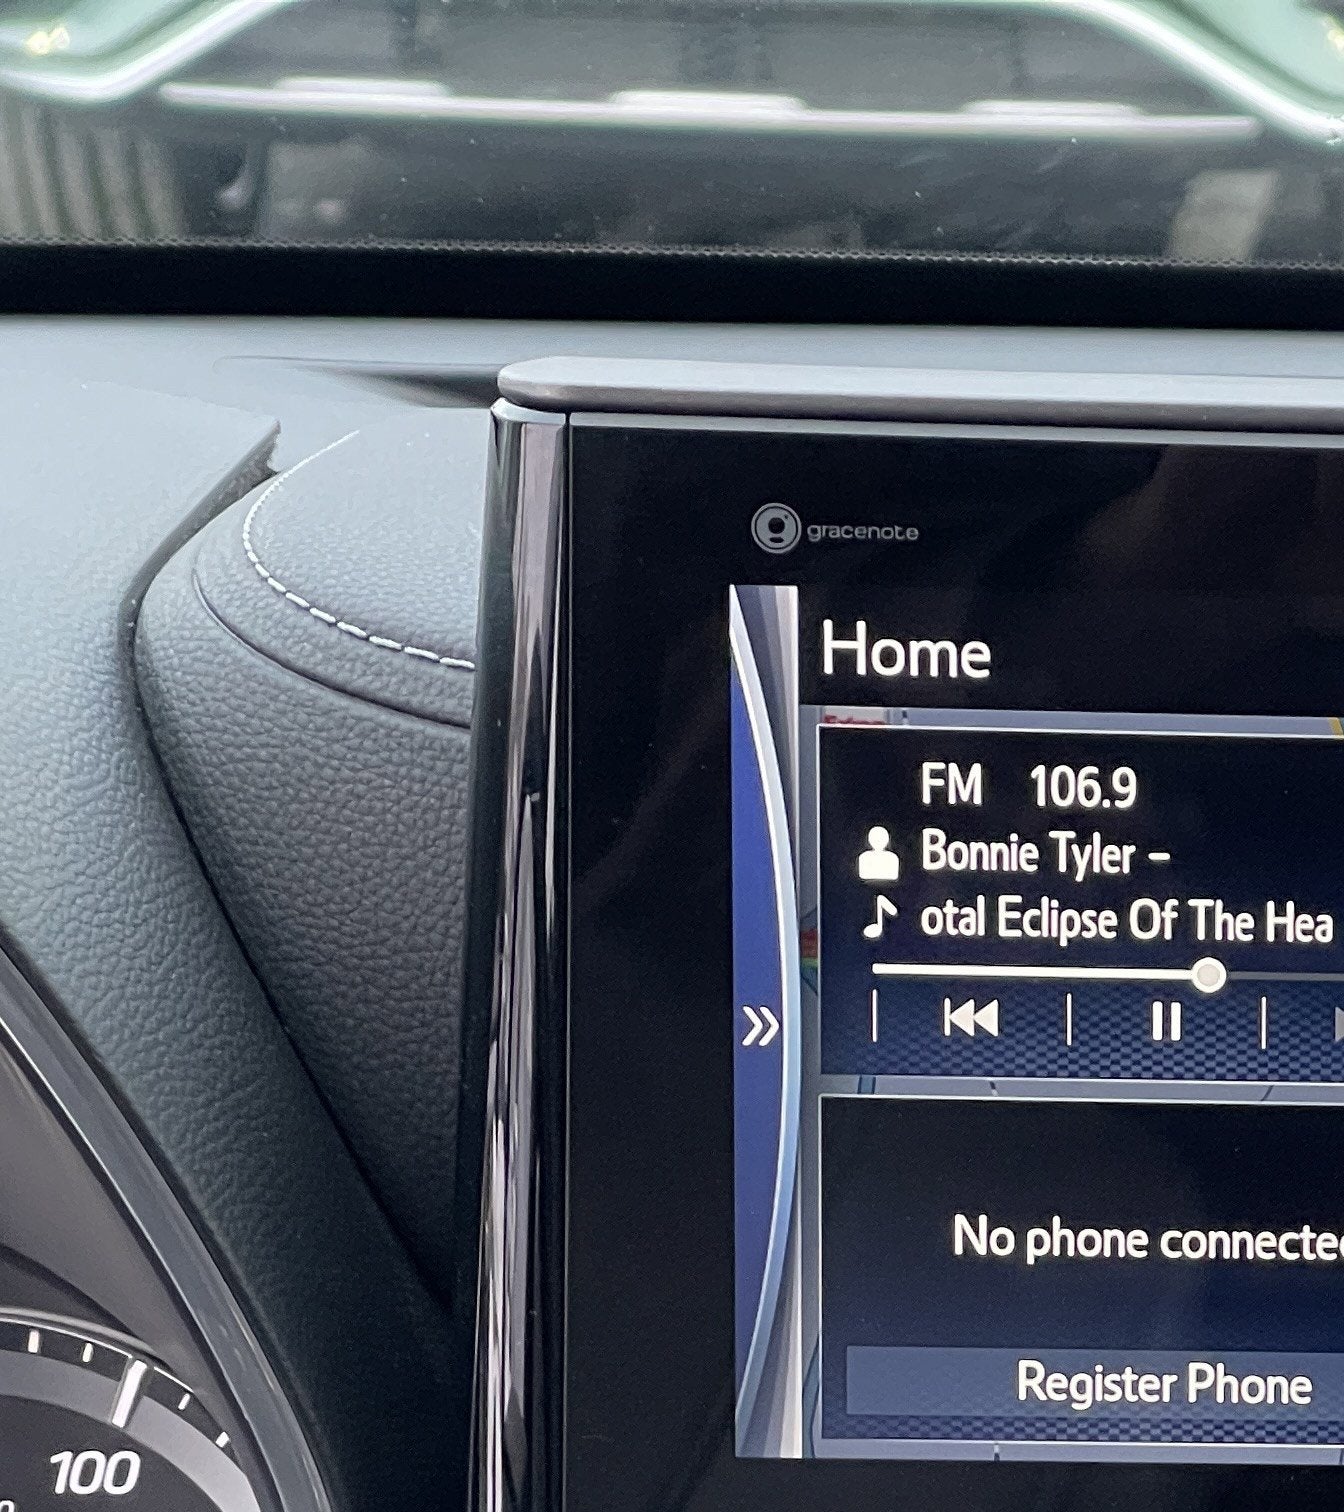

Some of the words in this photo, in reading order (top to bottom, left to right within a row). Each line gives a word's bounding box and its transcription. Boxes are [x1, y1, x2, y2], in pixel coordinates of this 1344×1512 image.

[806, 524, 919, 543] gracenote
[822, 618, 991, 679] Home
[922, 761, 983, 806] FM
[1030, 764, 1137, 809] 106.9
[922, 827, 1040, 873] Bonnie
[1048, 830, 1137, 883] Tyler
[920, 894, 986, 937] otal
[997, 894, 1118, 947] Eclipse
[1129, 897, 1179, 941] Of
[1187, 898, 1255, 942] The
[1266, 900, 1334, 943] Hea
[954, 1213, 1015, 1257] No
[1026, 1215, 1149, 1266] phone
[1018, 1359, 1178, 1411] Register
[1188, 1362, 1313, 1405] Phone
[50, 1450, 141, 1495] 100
